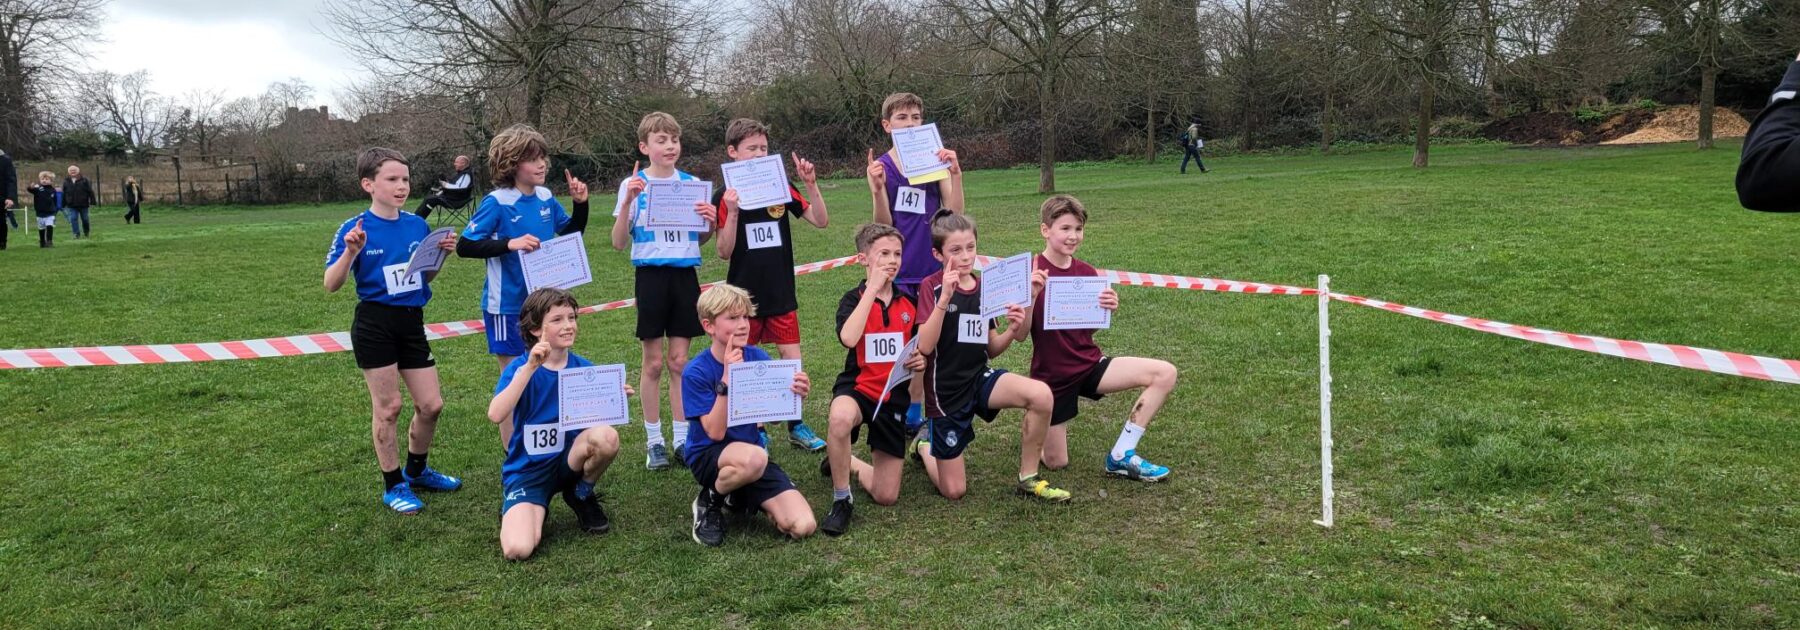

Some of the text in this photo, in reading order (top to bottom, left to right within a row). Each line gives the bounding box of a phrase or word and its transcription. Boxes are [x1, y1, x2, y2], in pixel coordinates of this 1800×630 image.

[901, 191, 920, 208] 147
[752, 226, 774, 243] 104
[966, 319, 983, 338] 113
[873, 338, 896, 357] 106
[531, 428, 558, 449] 138
